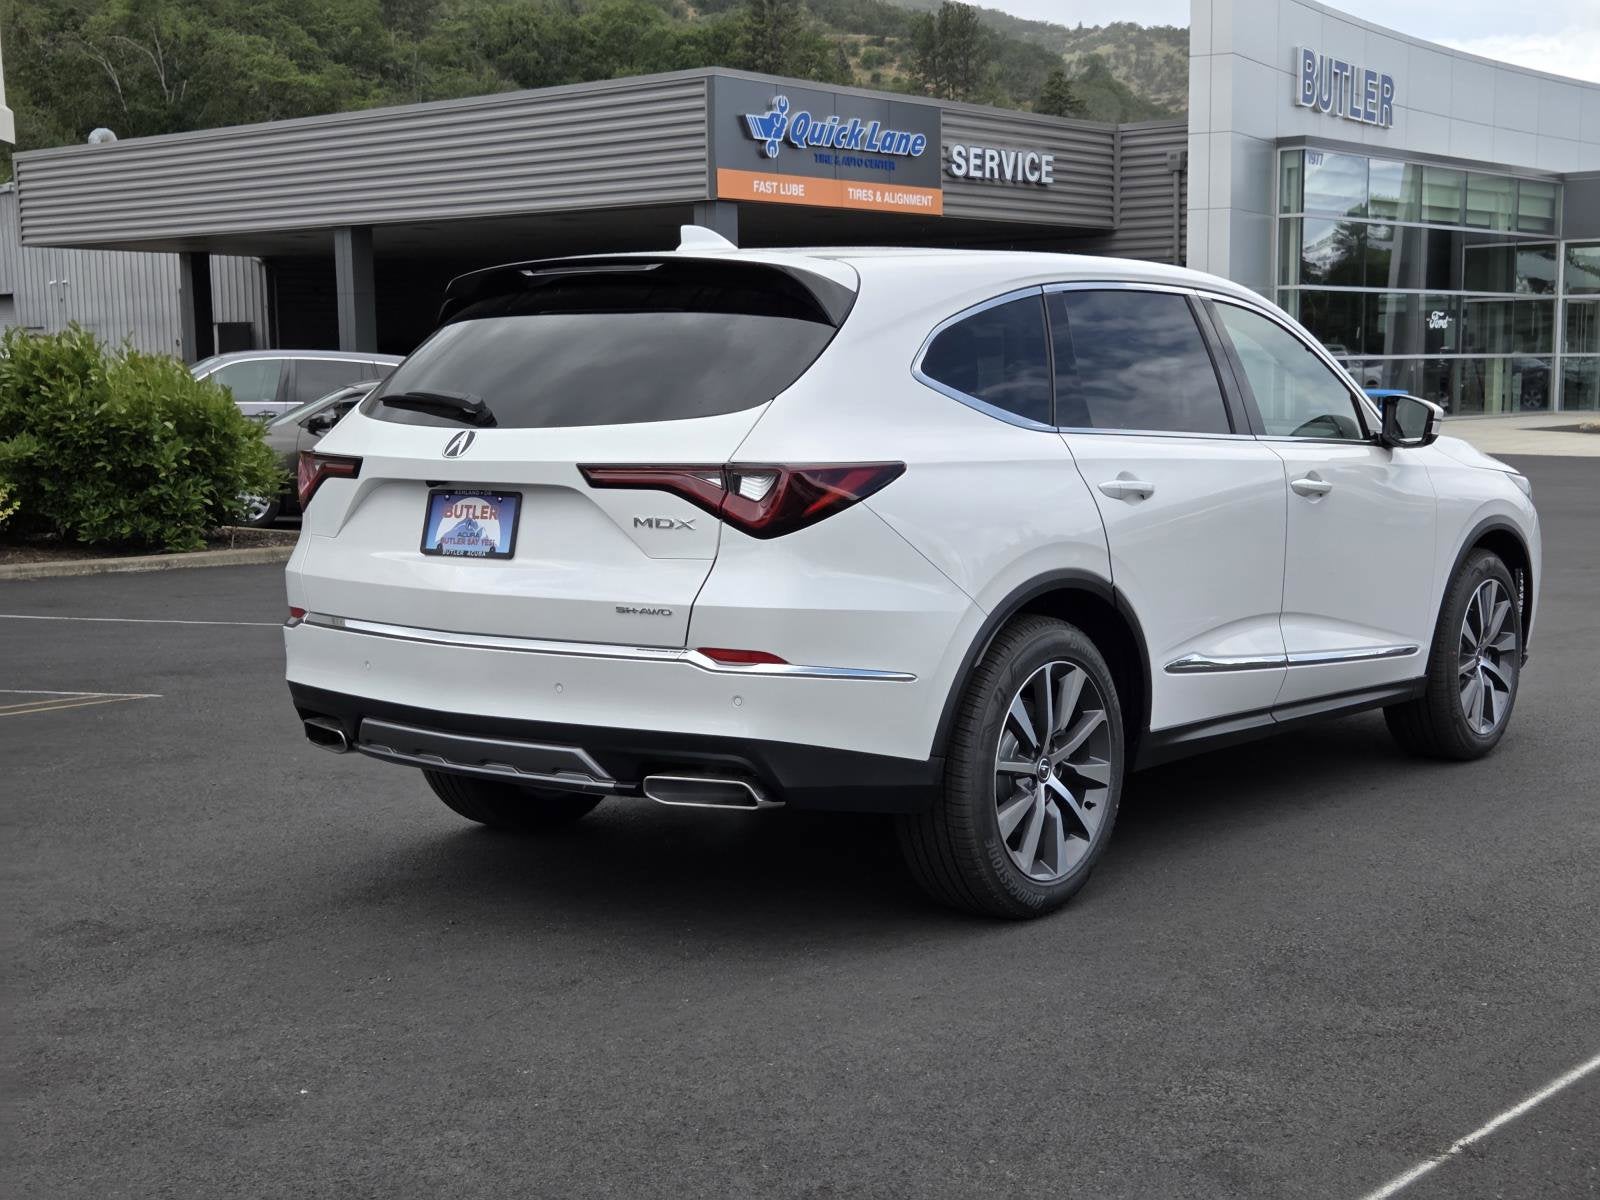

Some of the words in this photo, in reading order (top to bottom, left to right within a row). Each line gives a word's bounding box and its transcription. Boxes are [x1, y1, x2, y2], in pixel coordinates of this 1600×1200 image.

[1297, 46, 1396, 129] BUTLER
[789, 111, 866, 149] Quick
[865, 121, 927, 156] Lane
[951, 144, 1055, 184] SERVICE
[1308, 152, 1324, 167] 1977
[753, 180, 778, 194] FAST
[780, 182, 805, 197] LUBE
[848, 188, 874, 202] TIRES
[876, 191, 882, 202] &
[884, 192, 933, 207] ALIGNMENT
[1429, 310, 1449, 329] Ford
[443, 504, 497, 520] BUTLER
[633, 517, 697, 531] MDX
